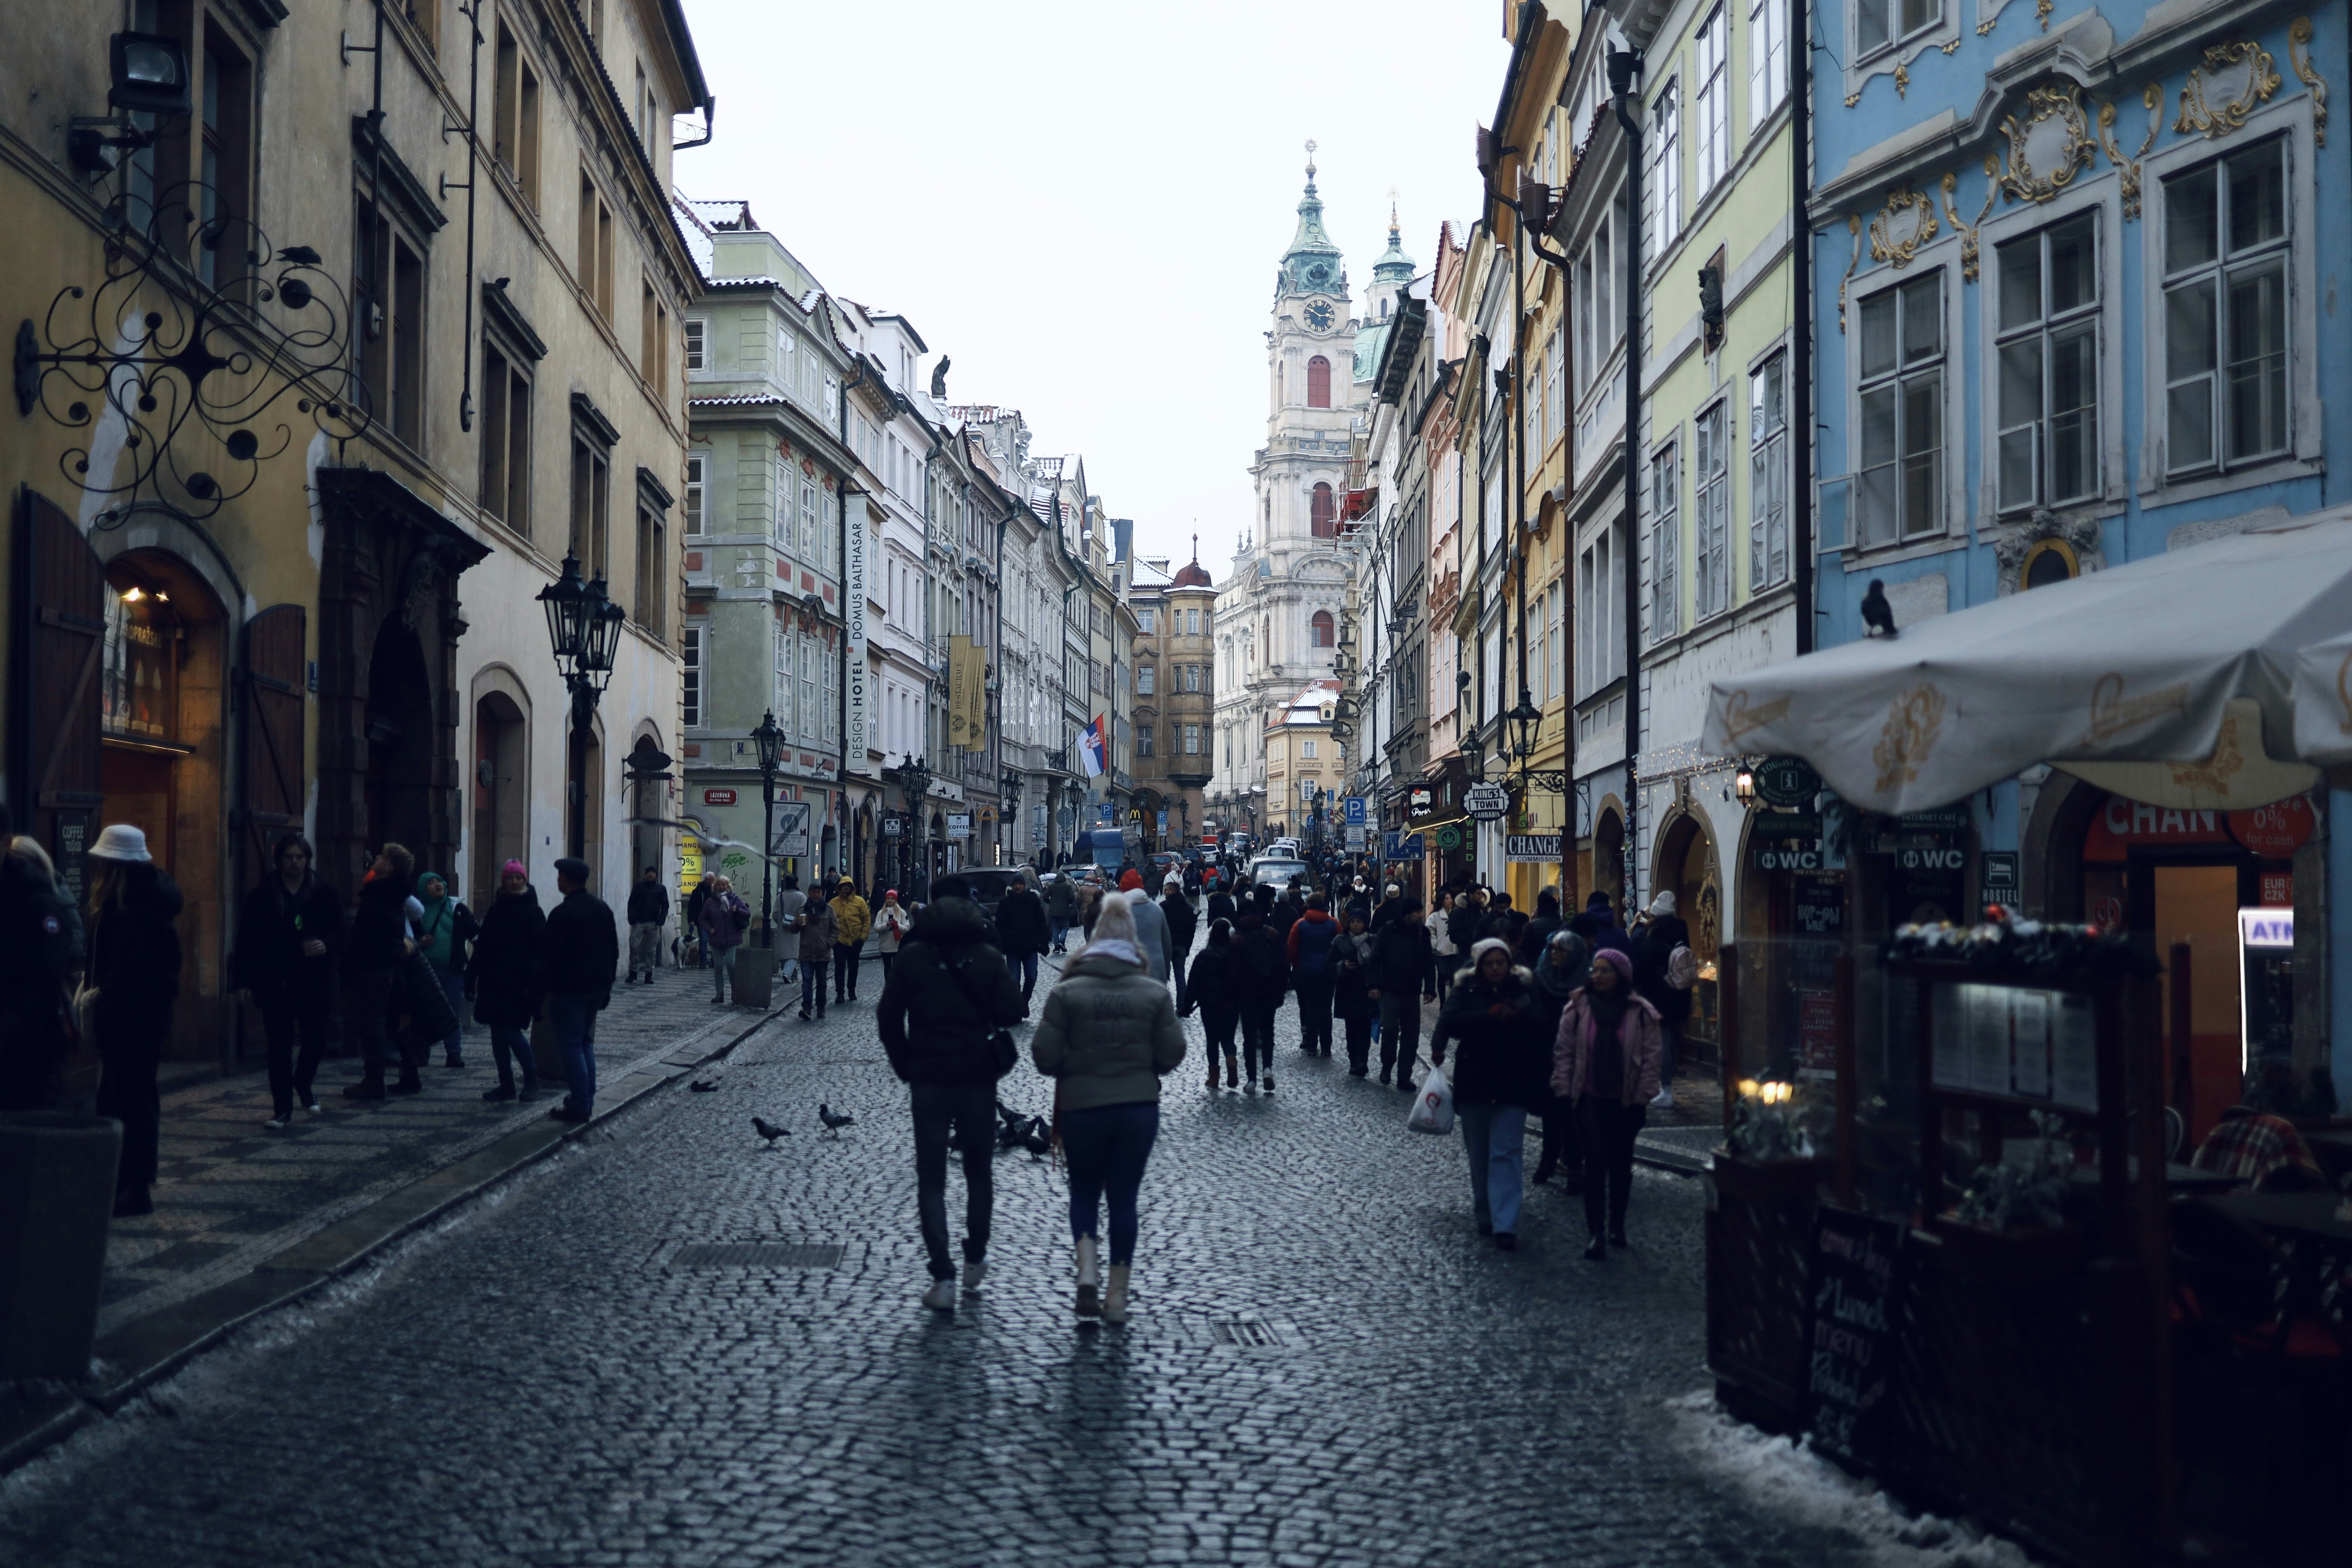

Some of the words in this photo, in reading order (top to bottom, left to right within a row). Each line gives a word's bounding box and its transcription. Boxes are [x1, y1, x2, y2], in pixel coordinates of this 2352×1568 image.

[853, 523, 862, 589] BALTHASAR
[853, 594, 862, 639] DOMUS
[853, 660, 862, 706] HOTEL
[853, 712, 862, 758] DESIGN
[1761, 759, 1793, 774] TOURIST
[1474, 789, 1499, 799] KING'S
[1350, 801, 1361, 816] P
[1475, 800, 1499, 809] TOWN
[1509, 836, 1560, 854] CHANGE
[2246, 832, 2263, 843] for
[2266, 835, 2294, 845] cash
[1779, 852, 1817, 869] WC
[1922, 850, 1963, 868] WC
[2264, 878, 2285, 889] EUR
[1983, 889, 2018, 902] HOSTEL
[2264, 890, 2285, 901] CZK
